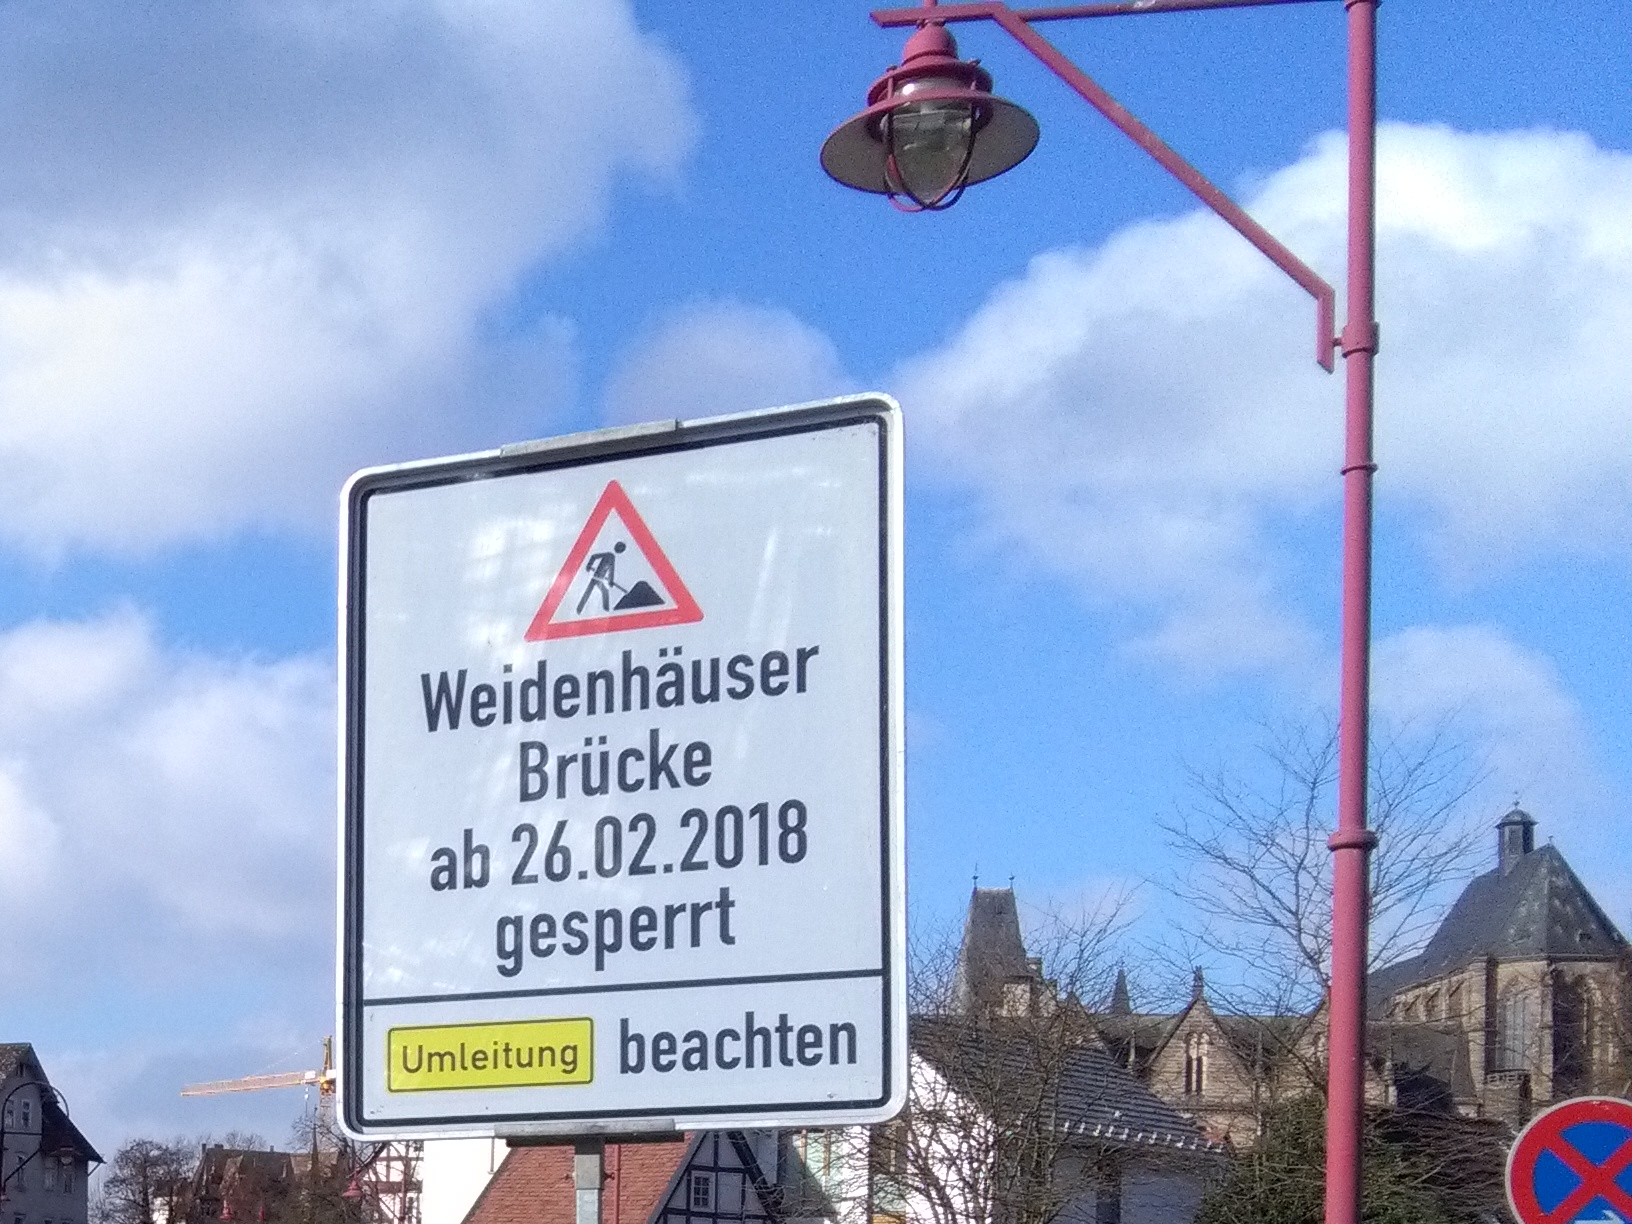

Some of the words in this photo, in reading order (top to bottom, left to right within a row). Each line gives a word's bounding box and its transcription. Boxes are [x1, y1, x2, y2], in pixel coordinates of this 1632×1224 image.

[420, 644, 820, 733] Weidenhäuser
[520, 728, 712, 803] Brücke
[430, 827, 491, 892] ab
[511, 799, 808, 886] 26.02.2018
[496, 886, 736, 978] gesperrt
[402, 1040, 579, 1075] Umleitung
[620, 1011, 858, 1075] beachten
